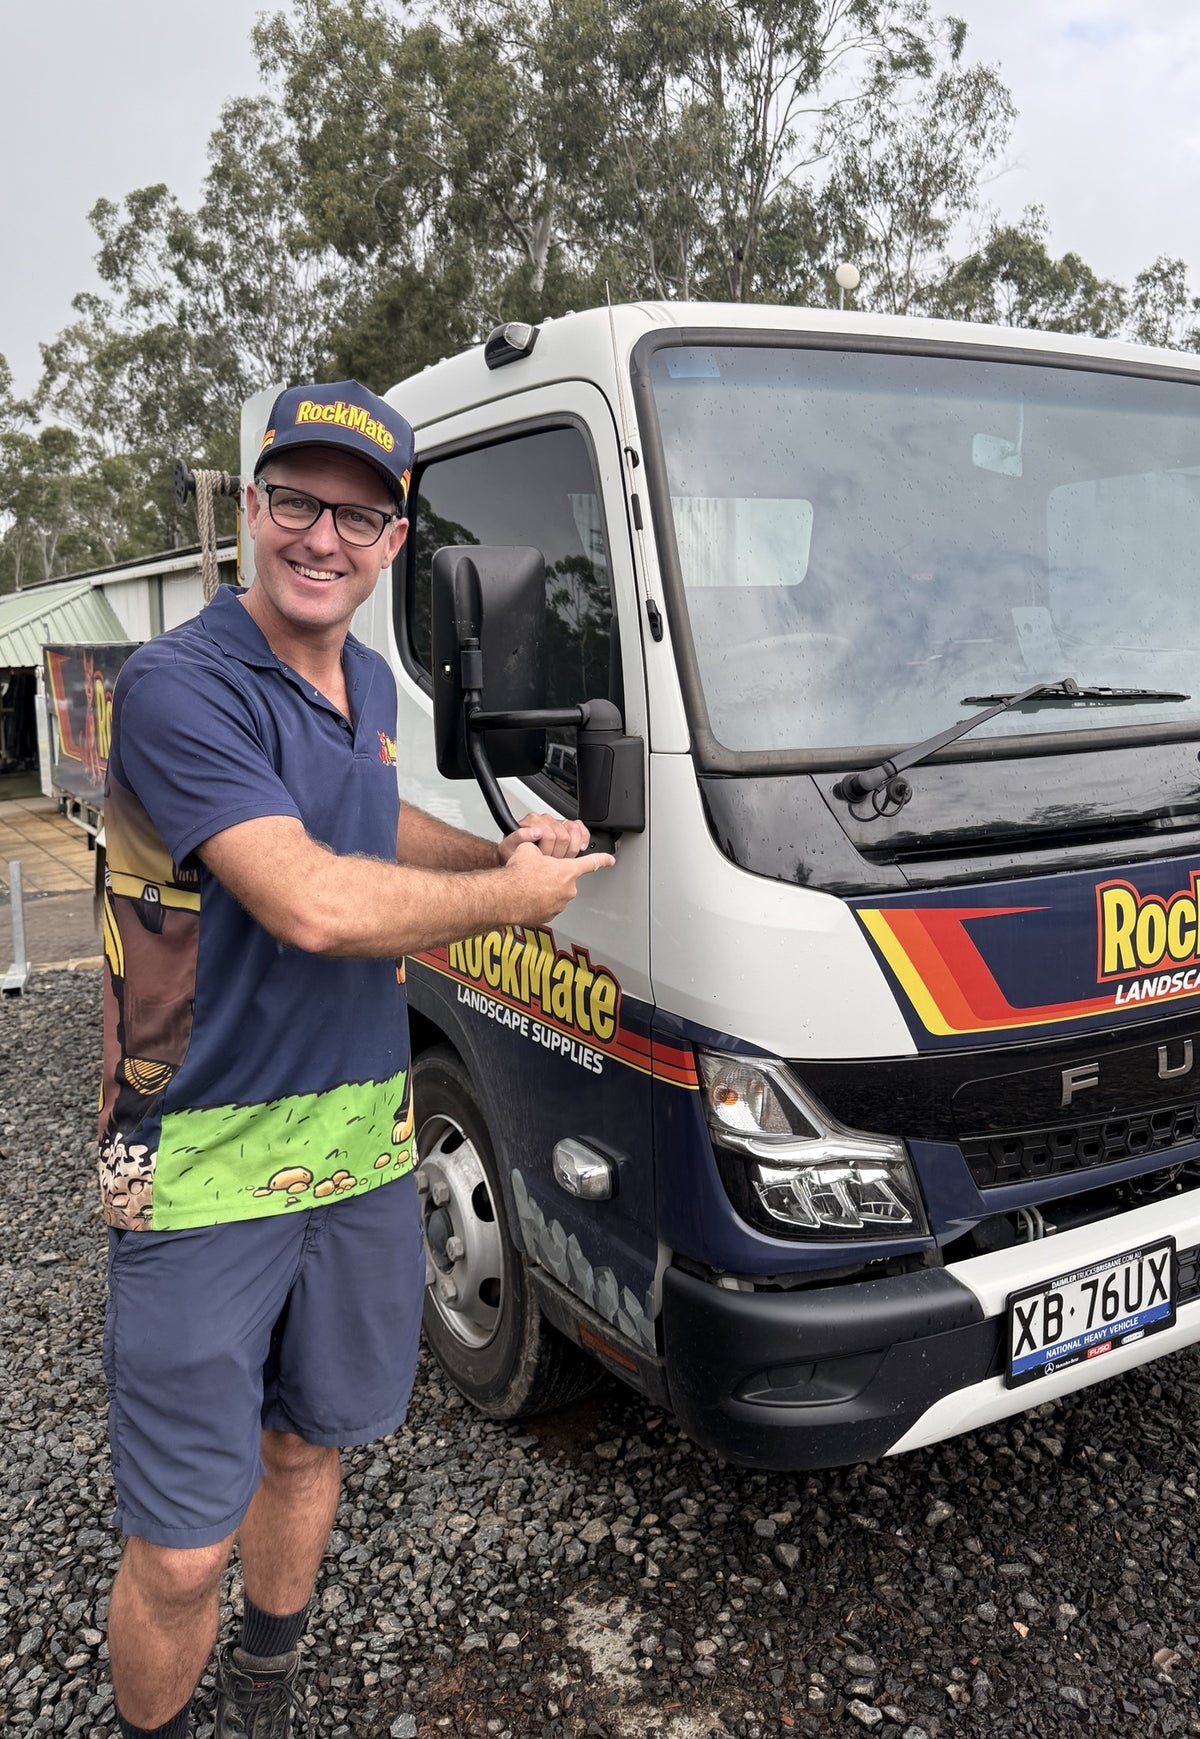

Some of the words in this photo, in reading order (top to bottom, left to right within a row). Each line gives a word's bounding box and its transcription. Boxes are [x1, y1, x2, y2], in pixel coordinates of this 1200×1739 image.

[296, 401, 395, 451] RockMate
[1101, 878, 1200, 974] Roc
[457, 984, 529, 1037] LANDSCAPE
[531, 1022, 604, 1076] SUPPLIES
[1046, 1340, 1082, 1359] NATIONAL
[1084, 1328, 1108, 1344] HEAVY
[1109, 1316, 1138, 1335] VEHICLE
[1089, 1343, 1110, 1357] FUSO
